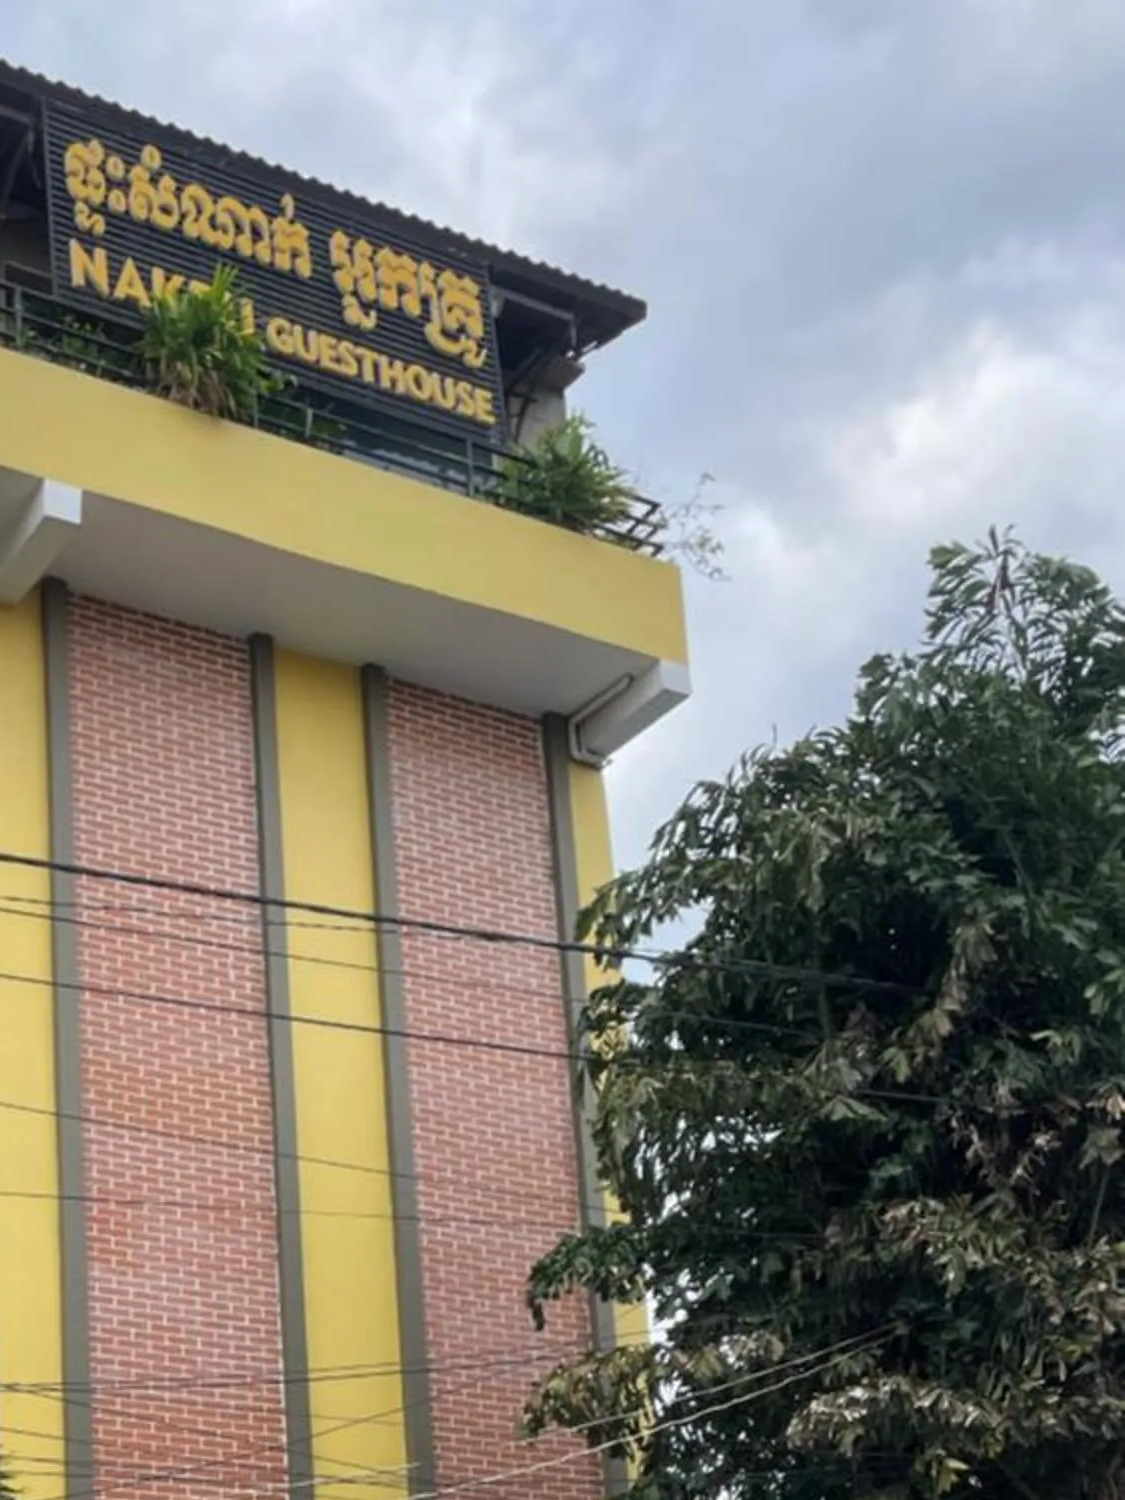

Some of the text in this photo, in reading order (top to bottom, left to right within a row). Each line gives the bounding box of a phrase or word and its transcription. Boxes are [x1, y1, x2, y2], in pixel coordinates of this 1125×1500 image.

[63, 137, 312, 279] ផ្ទះសំណាក់
[265, 315, 497, 425] GUESTHOUSE
